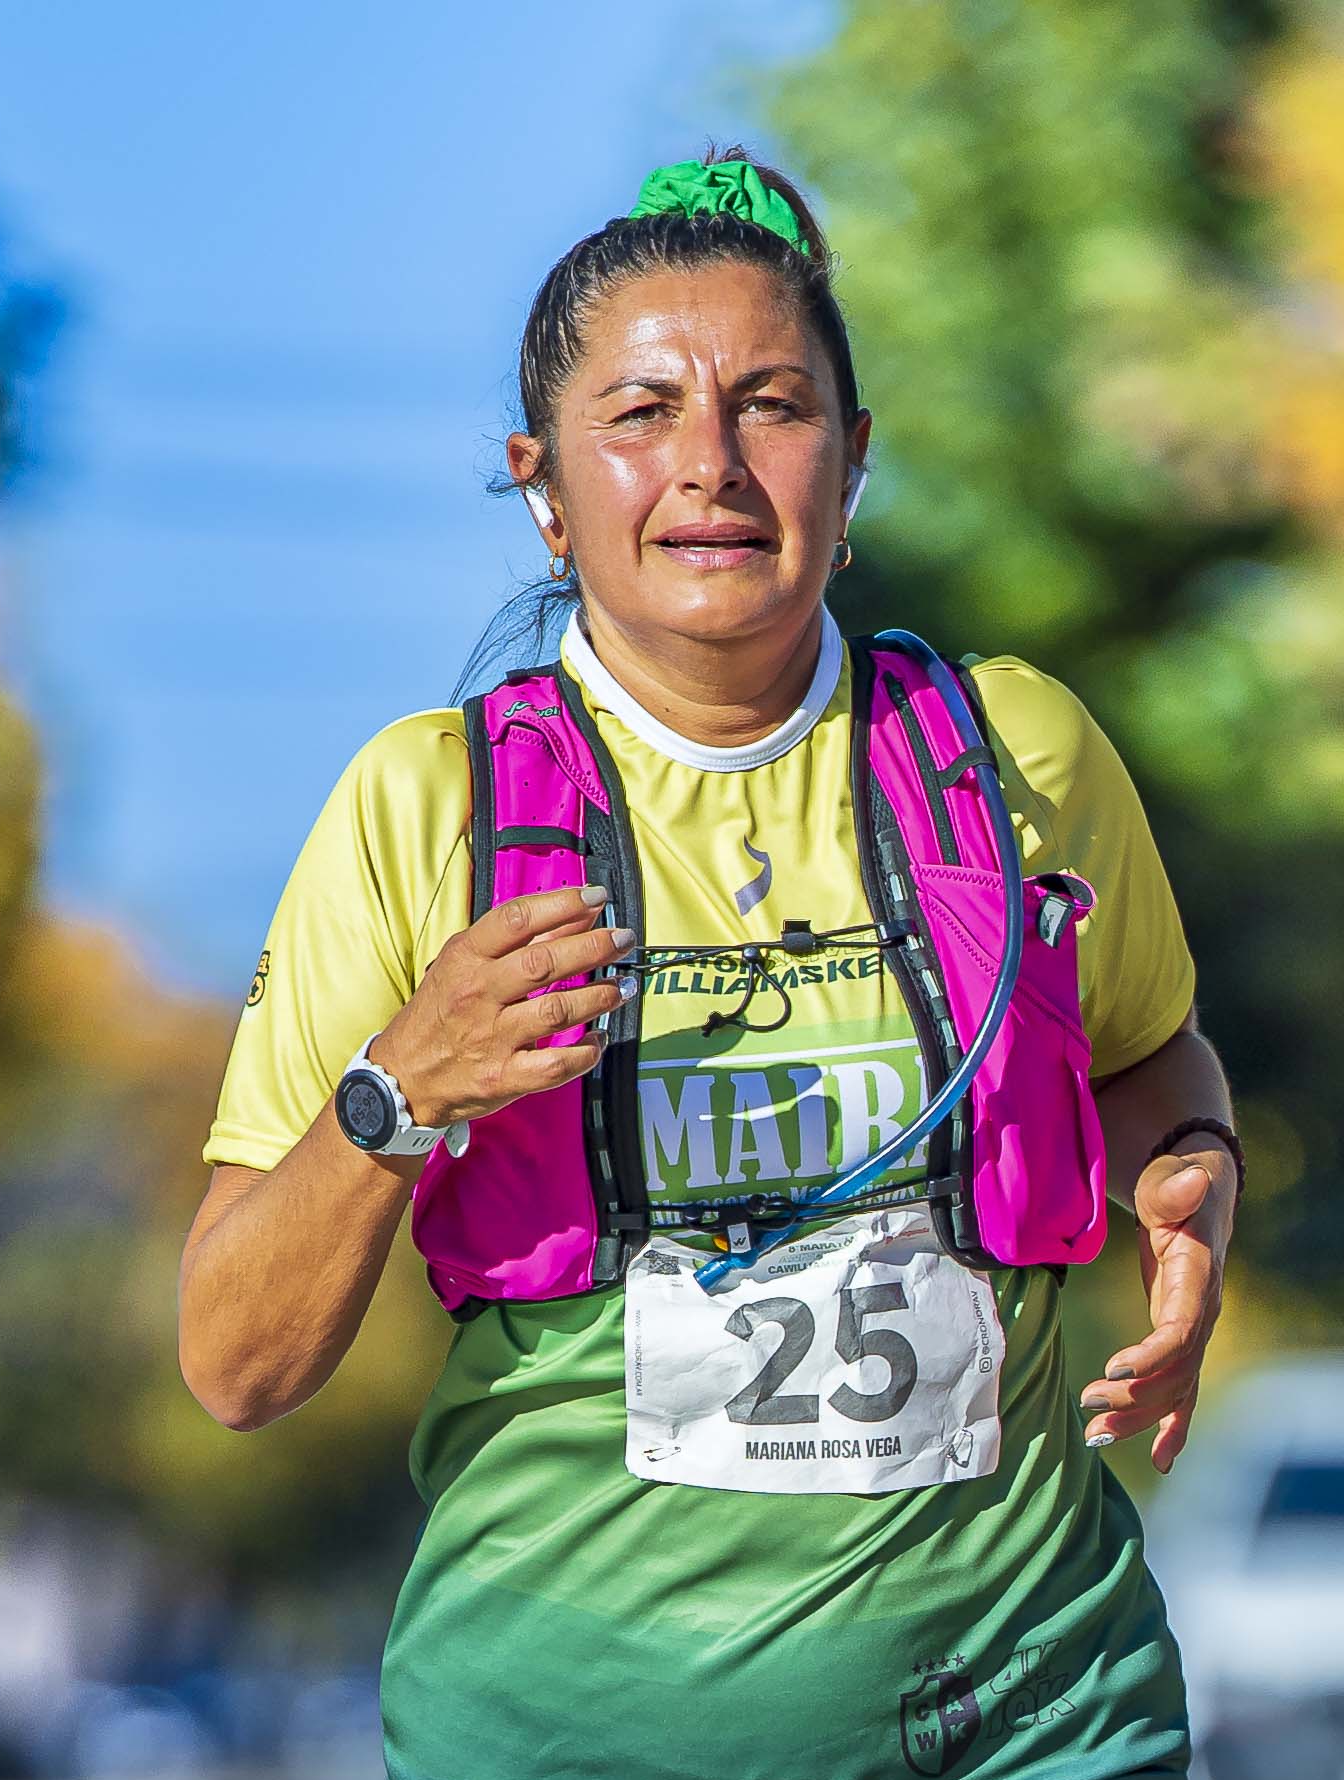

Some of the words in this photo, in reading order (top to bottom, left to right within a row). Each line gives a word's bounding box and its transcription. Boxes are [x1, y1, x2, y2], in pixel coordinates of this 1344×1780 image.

[724, 1282, 918, 1425] 25
[971, 1290, 991, 1356] @CRONDRAV
[745, 1441, 817, 1460] MARIANA
[821, 1439, 862, 1459] ROSA
[866, 1435, 902, 1457] VEGA
